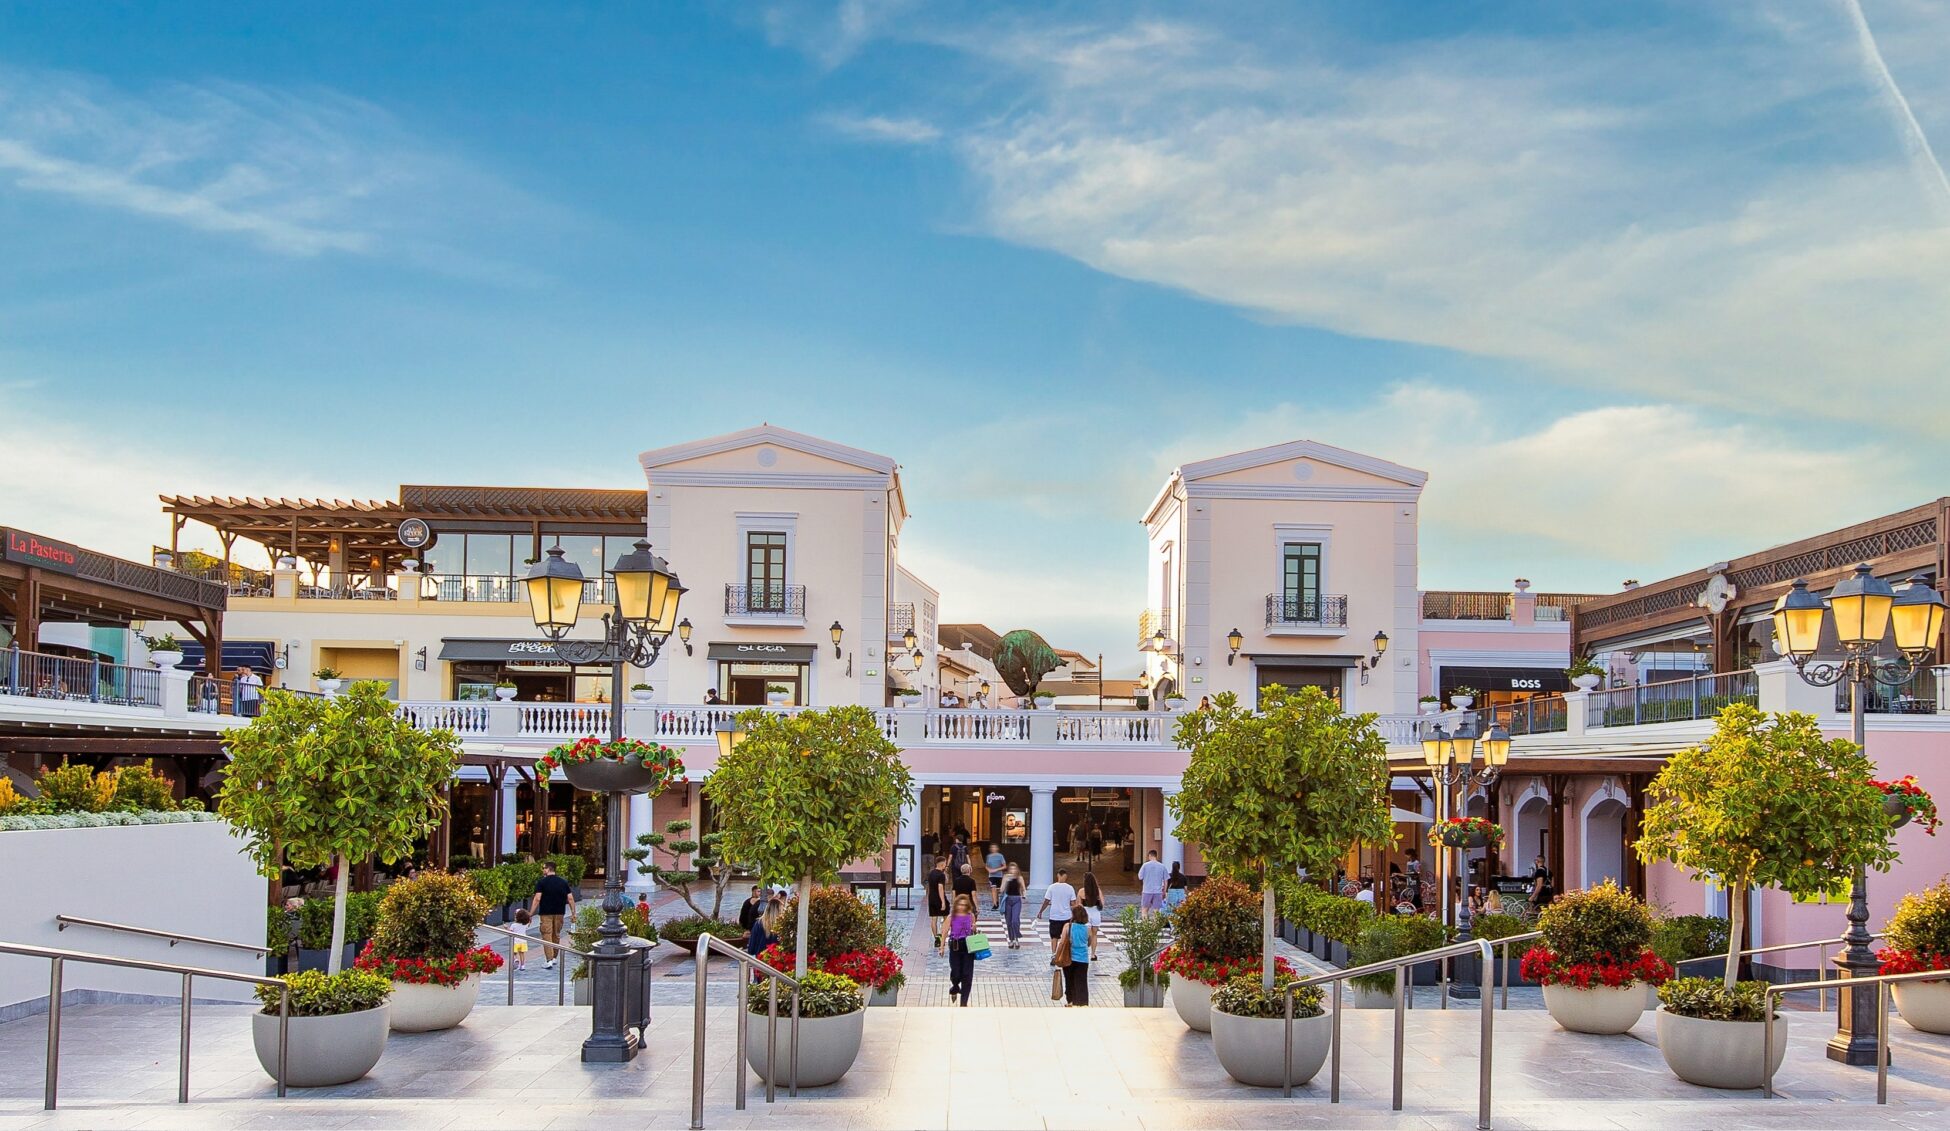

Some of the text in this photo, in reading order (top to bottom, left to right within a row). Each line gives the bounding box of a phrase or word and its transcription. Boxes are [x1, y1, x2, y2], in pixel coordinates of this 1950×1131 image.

[11, 533, 26, 553] La
[30, 538, 75, 564] Pasteria
[1511, 678, 1542, 688] BOSS
